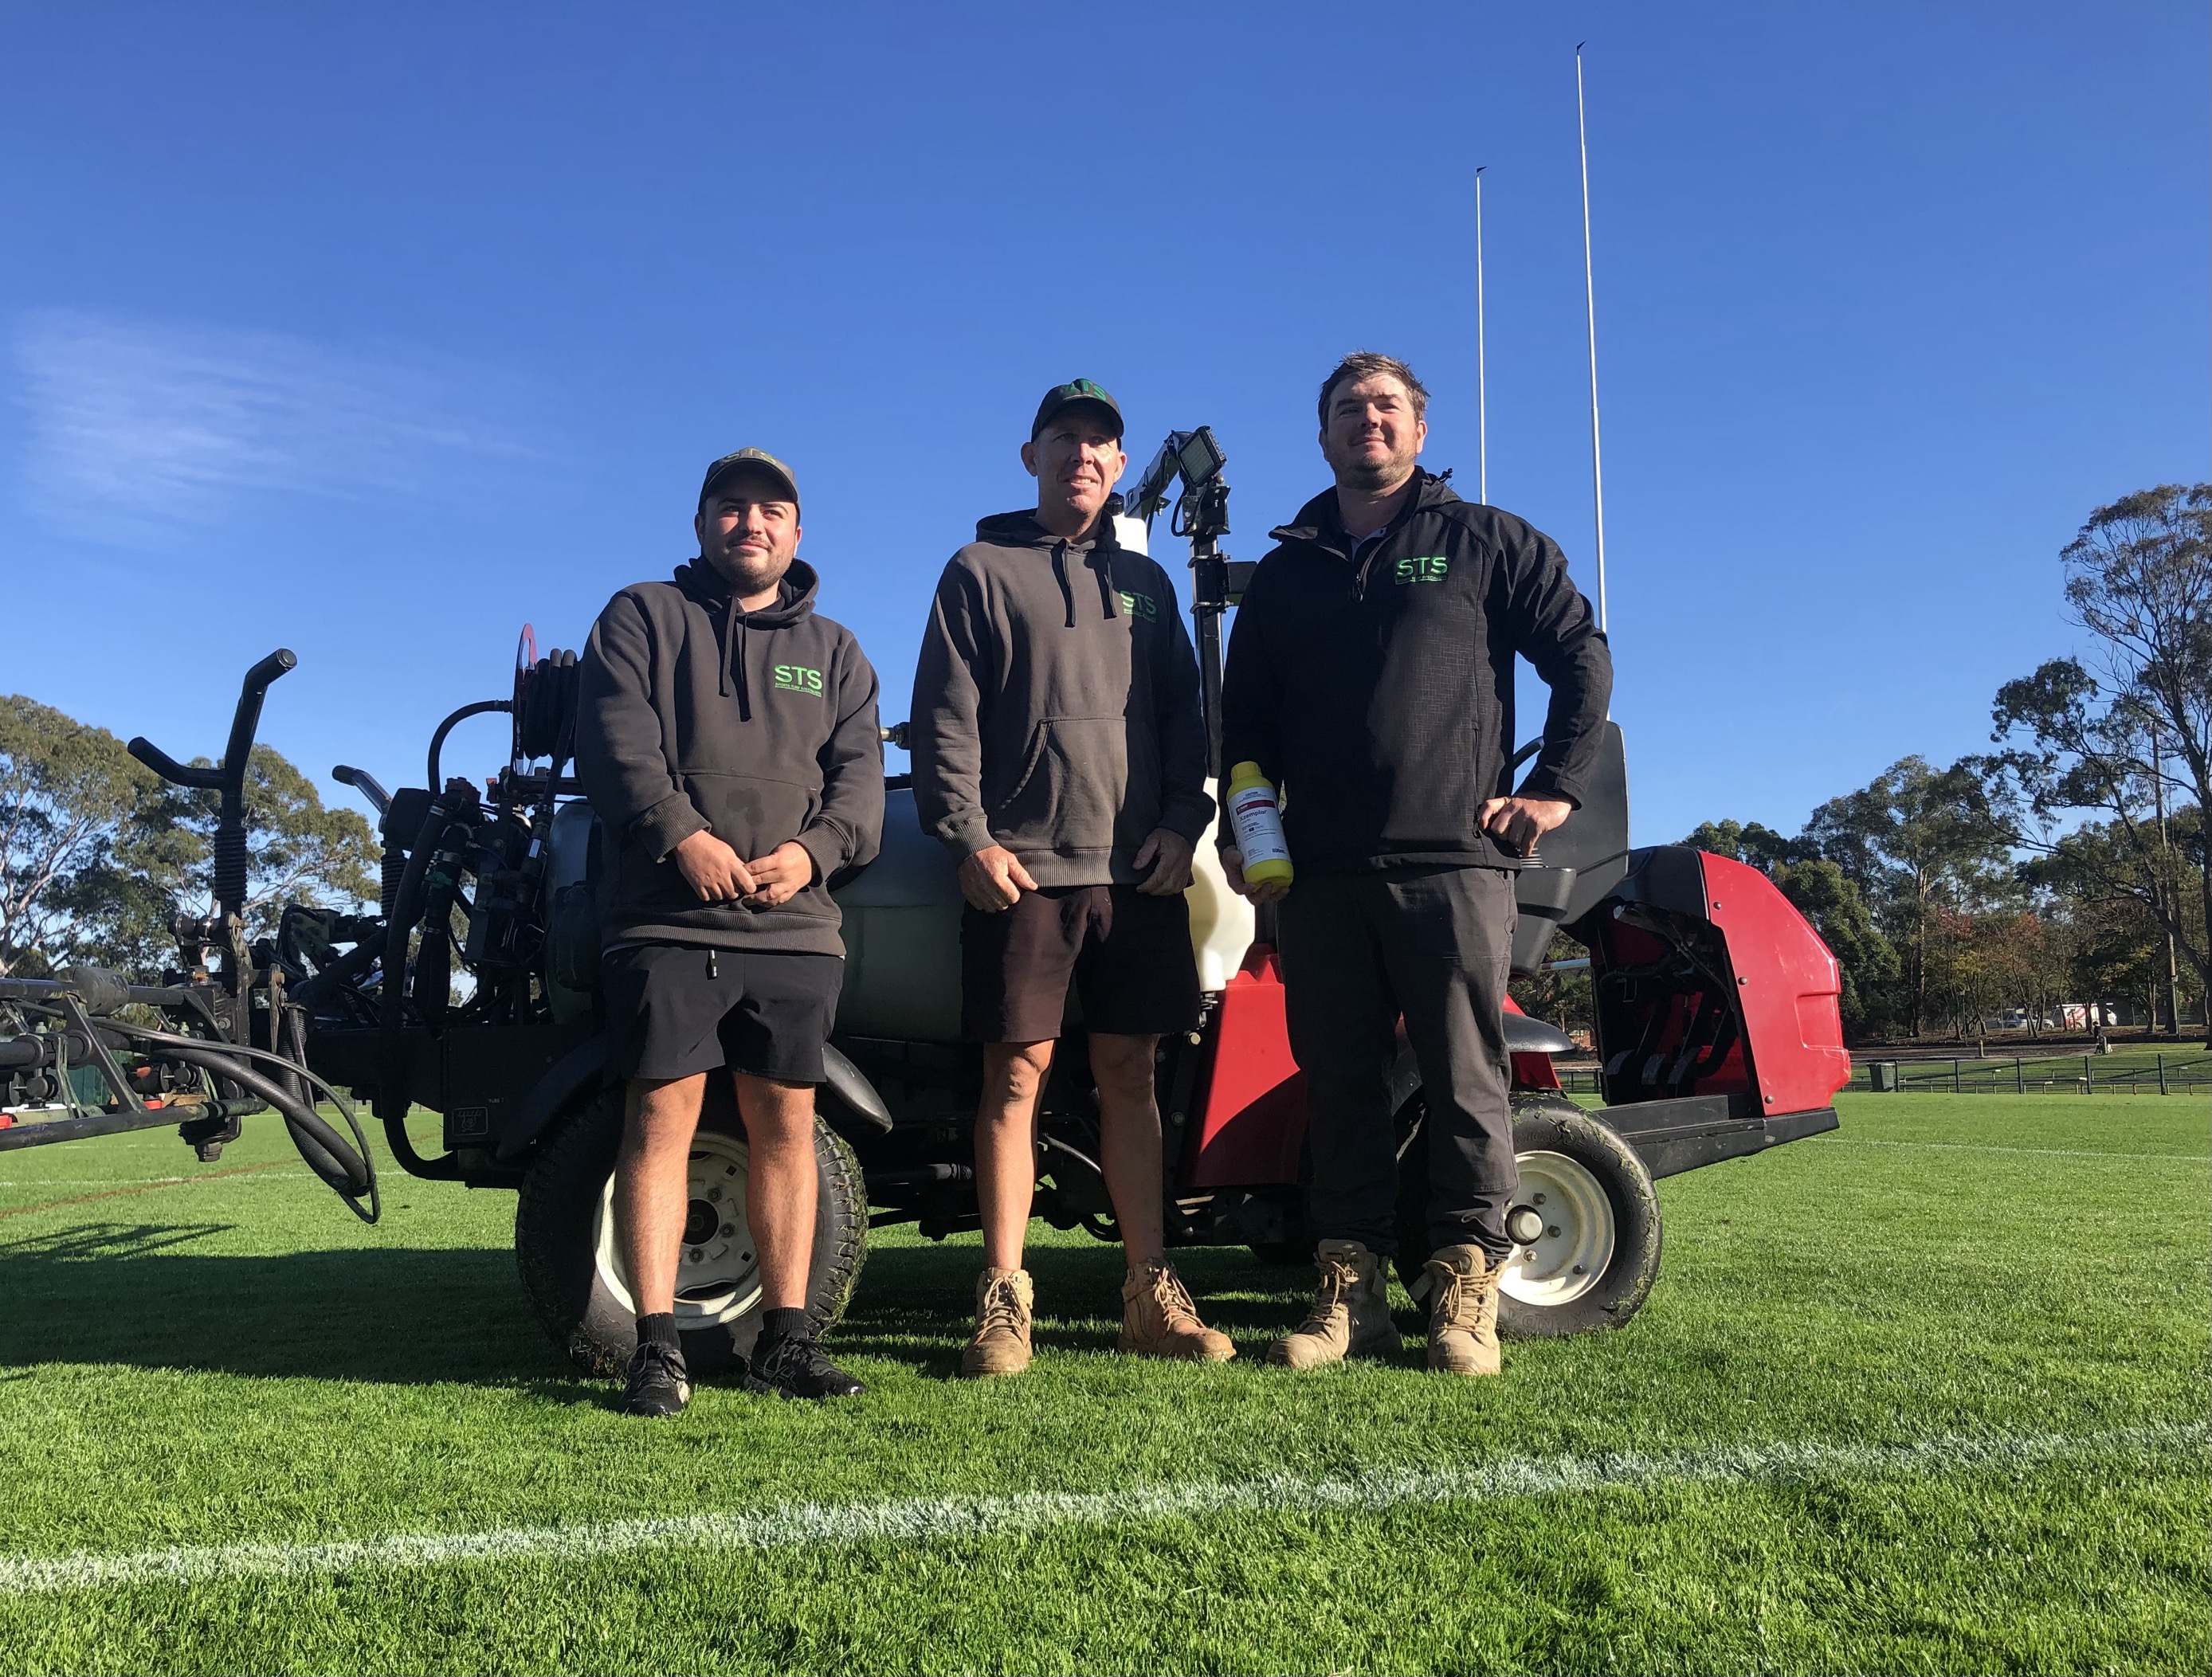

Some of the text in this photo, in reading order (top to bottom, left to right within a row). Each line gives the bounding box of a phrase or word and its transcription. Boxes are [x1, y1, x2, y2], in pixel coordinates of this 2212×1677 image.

[1397, 557, 1448, 578] STS
[1120, 590, 1157, 615] STS
[775, 664, 823, 691] STS
[1239, 809, 1267, 821] Xzemplar
